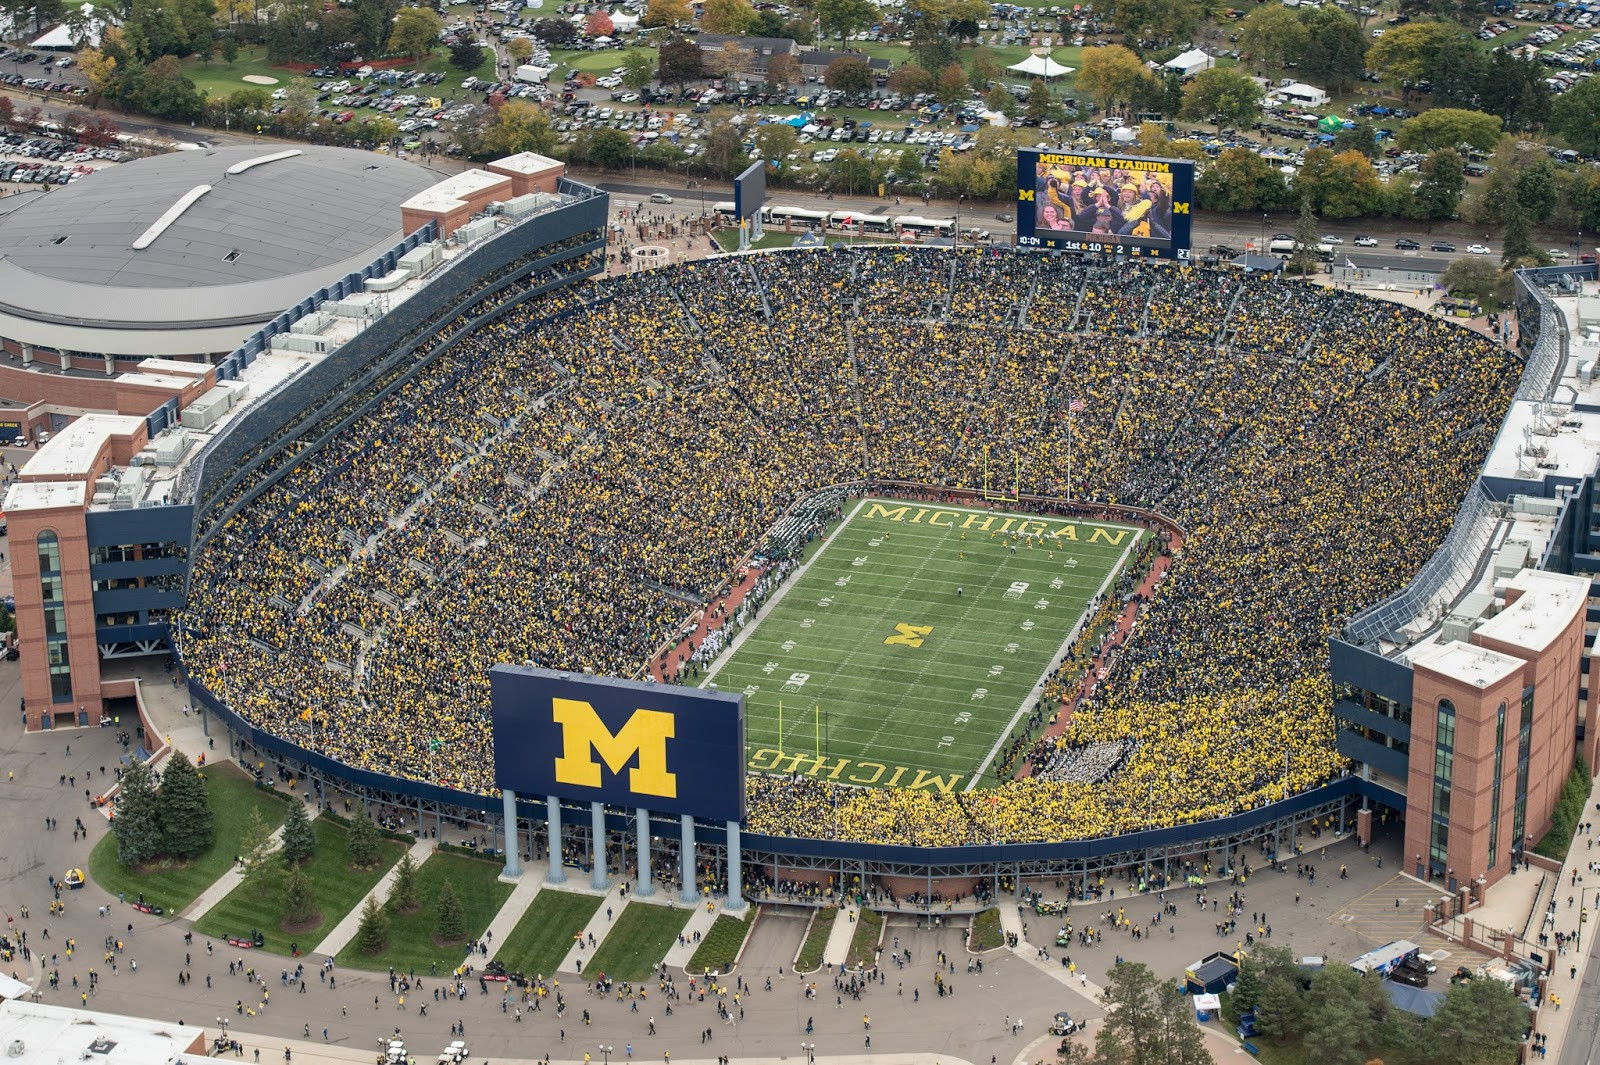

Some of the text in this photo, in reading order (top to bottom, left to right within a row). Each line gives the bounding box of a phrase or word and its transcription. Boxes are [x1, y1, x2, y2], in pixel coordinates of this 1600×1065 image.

[1039, 154, 1169, 172] MICHIGAN STADIUM
[1018, 189, 1035, 202] M
[1173, 201, 1190, 214] M
[1066, 241, 1080, 250] 1st
[1089, 243, 1101, 251] 10
[1116, 245, 1124, 254] 2
[862, 503, 1130, 546] MICHIGAN
[883, 622, 934, 648] M
[956, 711, 972, 723] 20
[552, 697, 677, 798] M
[940, 736, 955, 747] 10
